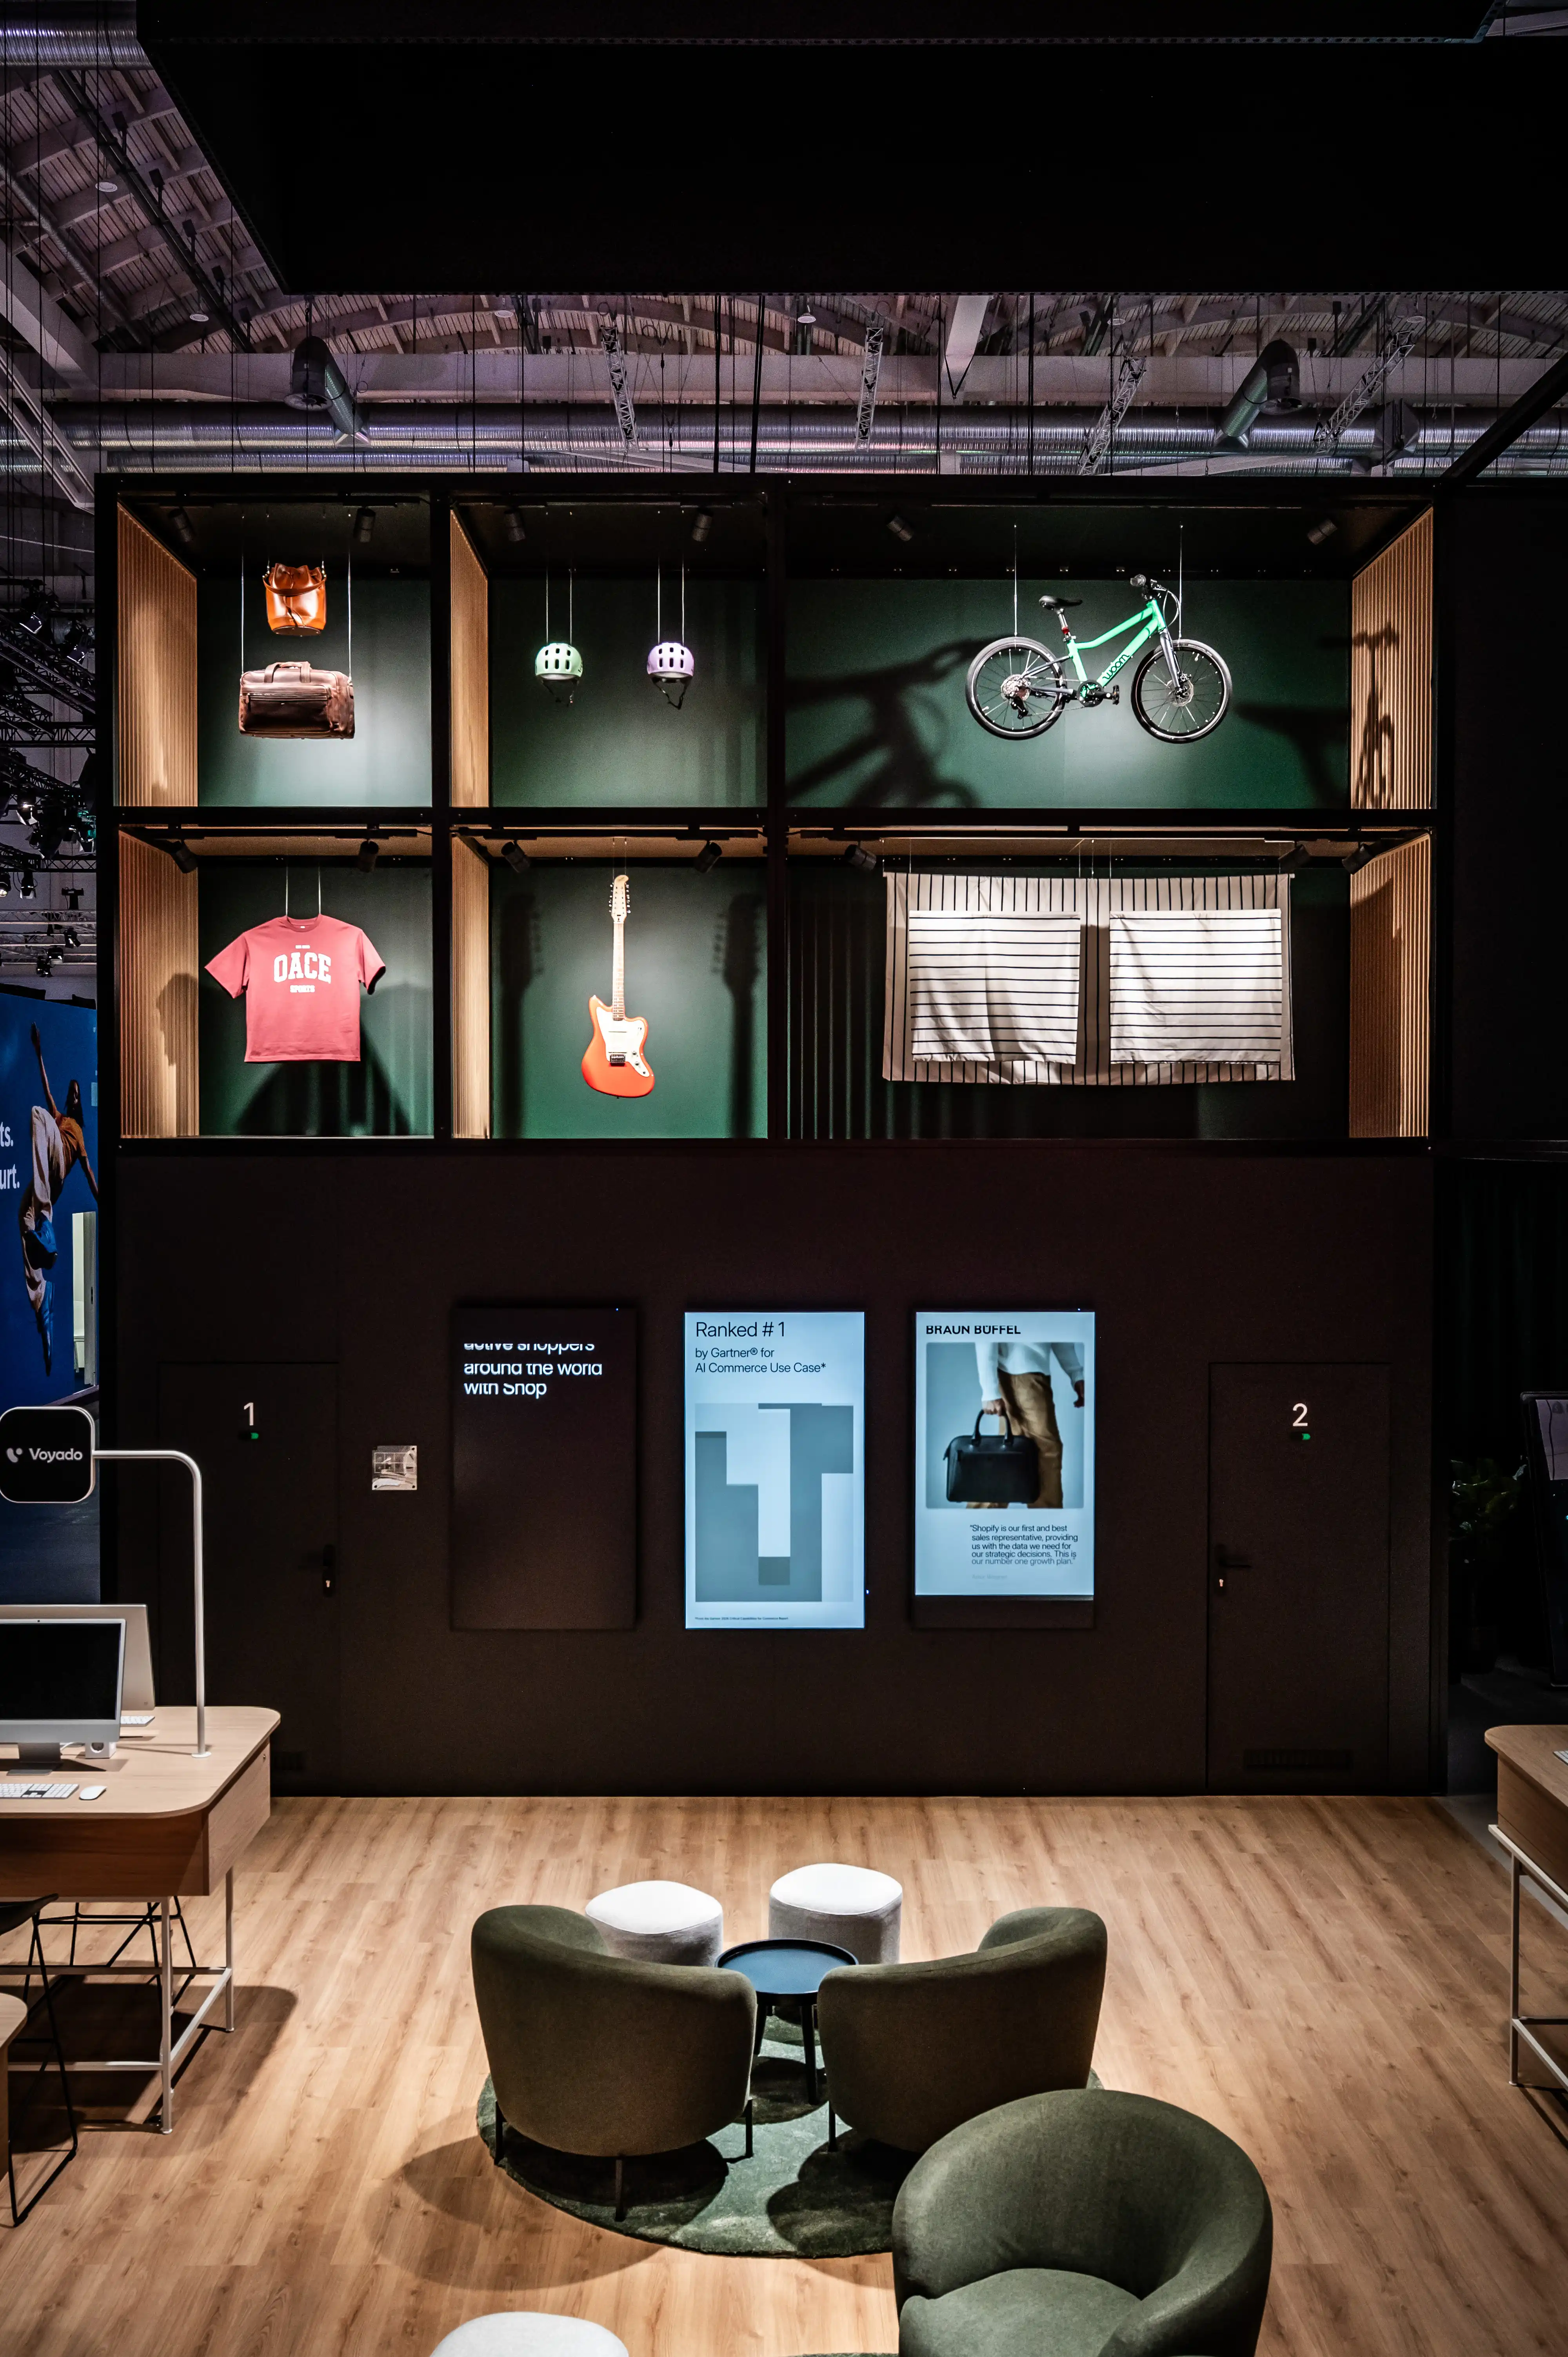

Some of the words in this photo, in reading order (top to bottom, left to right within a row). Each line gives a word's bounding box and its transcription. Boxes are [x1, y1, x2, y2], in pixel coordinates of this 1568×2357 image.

[1102, 654, 1130, 679] woom
[274, 952, 331, 984] OACE
[696, 1321, 757, 1337] Ranked
[926, 1325, 970, 1335] BRAUN
[695, 1348, 708, 1360] by
[760, 1347, 775, 1357] for
[695, 1362, 705, 1373] AI
[709, 1362, 767, 1373] Commerce
[770, 1362, 791, 1373] Use
[243, 1402, 254, 1426] 1
[1292, 1403, 1308, 1427] 2
[29, 1448, 83, 1463] Voyado
[992, 1534, 1044, 1542] representative,
[1045, 1533, 1078, 1542] providing
[985, 1550, 1016, 1559] strategic
[1030, 1558, 1055, 1566] growth
